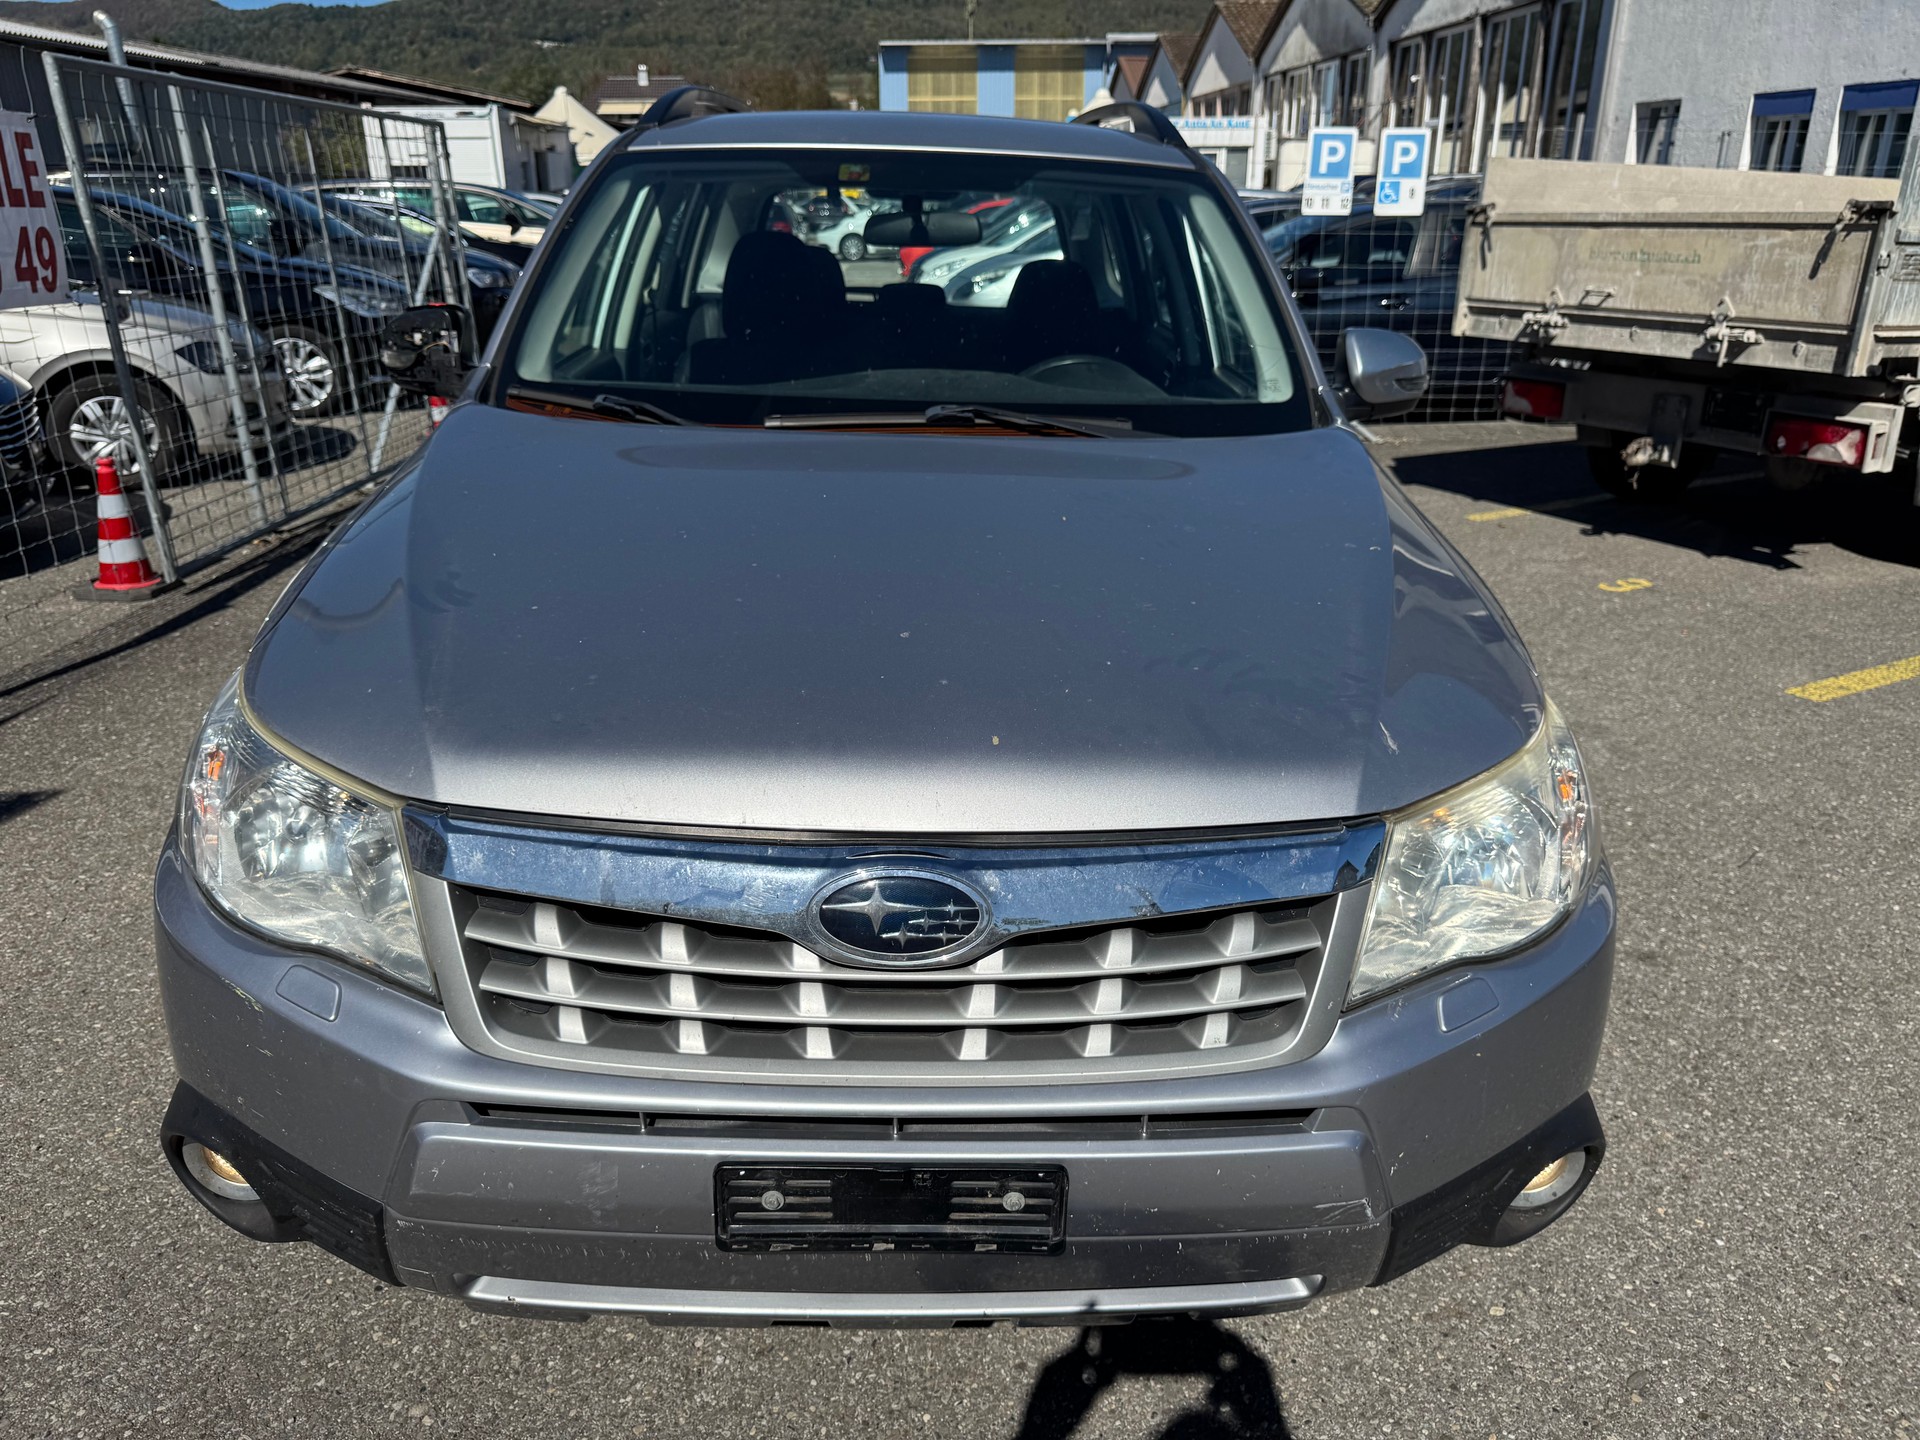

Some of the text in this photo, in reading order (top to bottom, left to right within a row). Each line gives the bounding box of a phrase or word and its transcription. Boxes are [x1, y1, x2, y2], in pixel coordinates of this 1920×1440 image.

[0, 131, 46, 208] LE
[1319, 140, 1346, 175] P
[1391, 140, 1419, 175] P
[15, 226, 57, 293] 49
